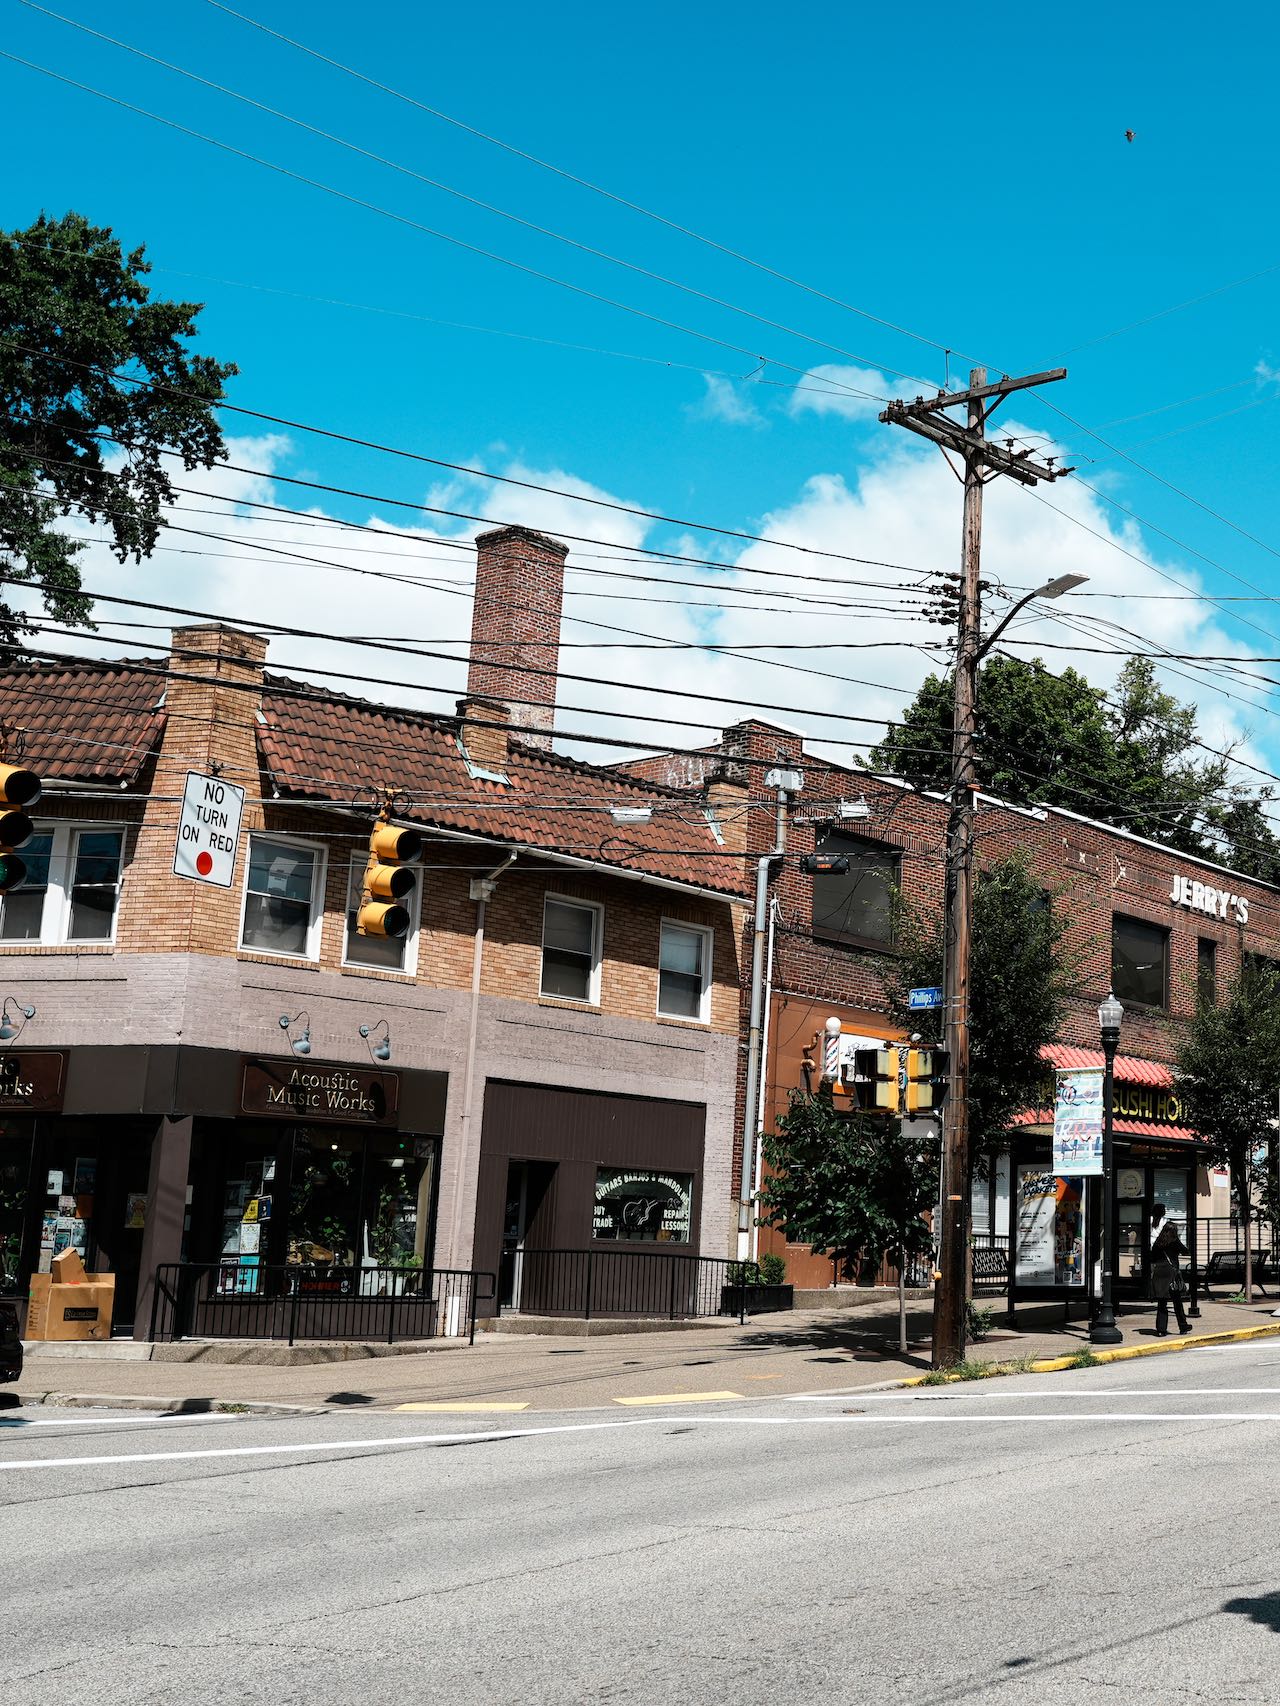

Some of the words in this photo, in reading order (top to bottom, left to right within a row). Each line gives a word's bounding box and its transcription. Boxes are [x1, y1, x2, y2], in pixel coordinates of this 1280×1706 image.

[204, 782, 225, 805] NO
[196, 804, 228, 828] TURN
[182, 824, 200, 843] ON
[209, 832, 234, 853] RED
[1169, 874, 1249, 924] JERRY'S
[911, 991, 932, 1007] Phillips
[288, 1068, 359, 1091] Acoustic
[266, 1084, 320, 1107] Music
[325, 1090, 376, 1112] Works
[1112, 1087, 1153, 1118] SUSHI
[595, 1175, 623, 1200] GUITARS
[624, 1171, 650, 1183] BANJOS
[658, 1174, 690, 1205] MANDOLINS
[661, 1220, 688, 1231] LESSONS
[663, 1209, 689, 1219] REPAIRS
